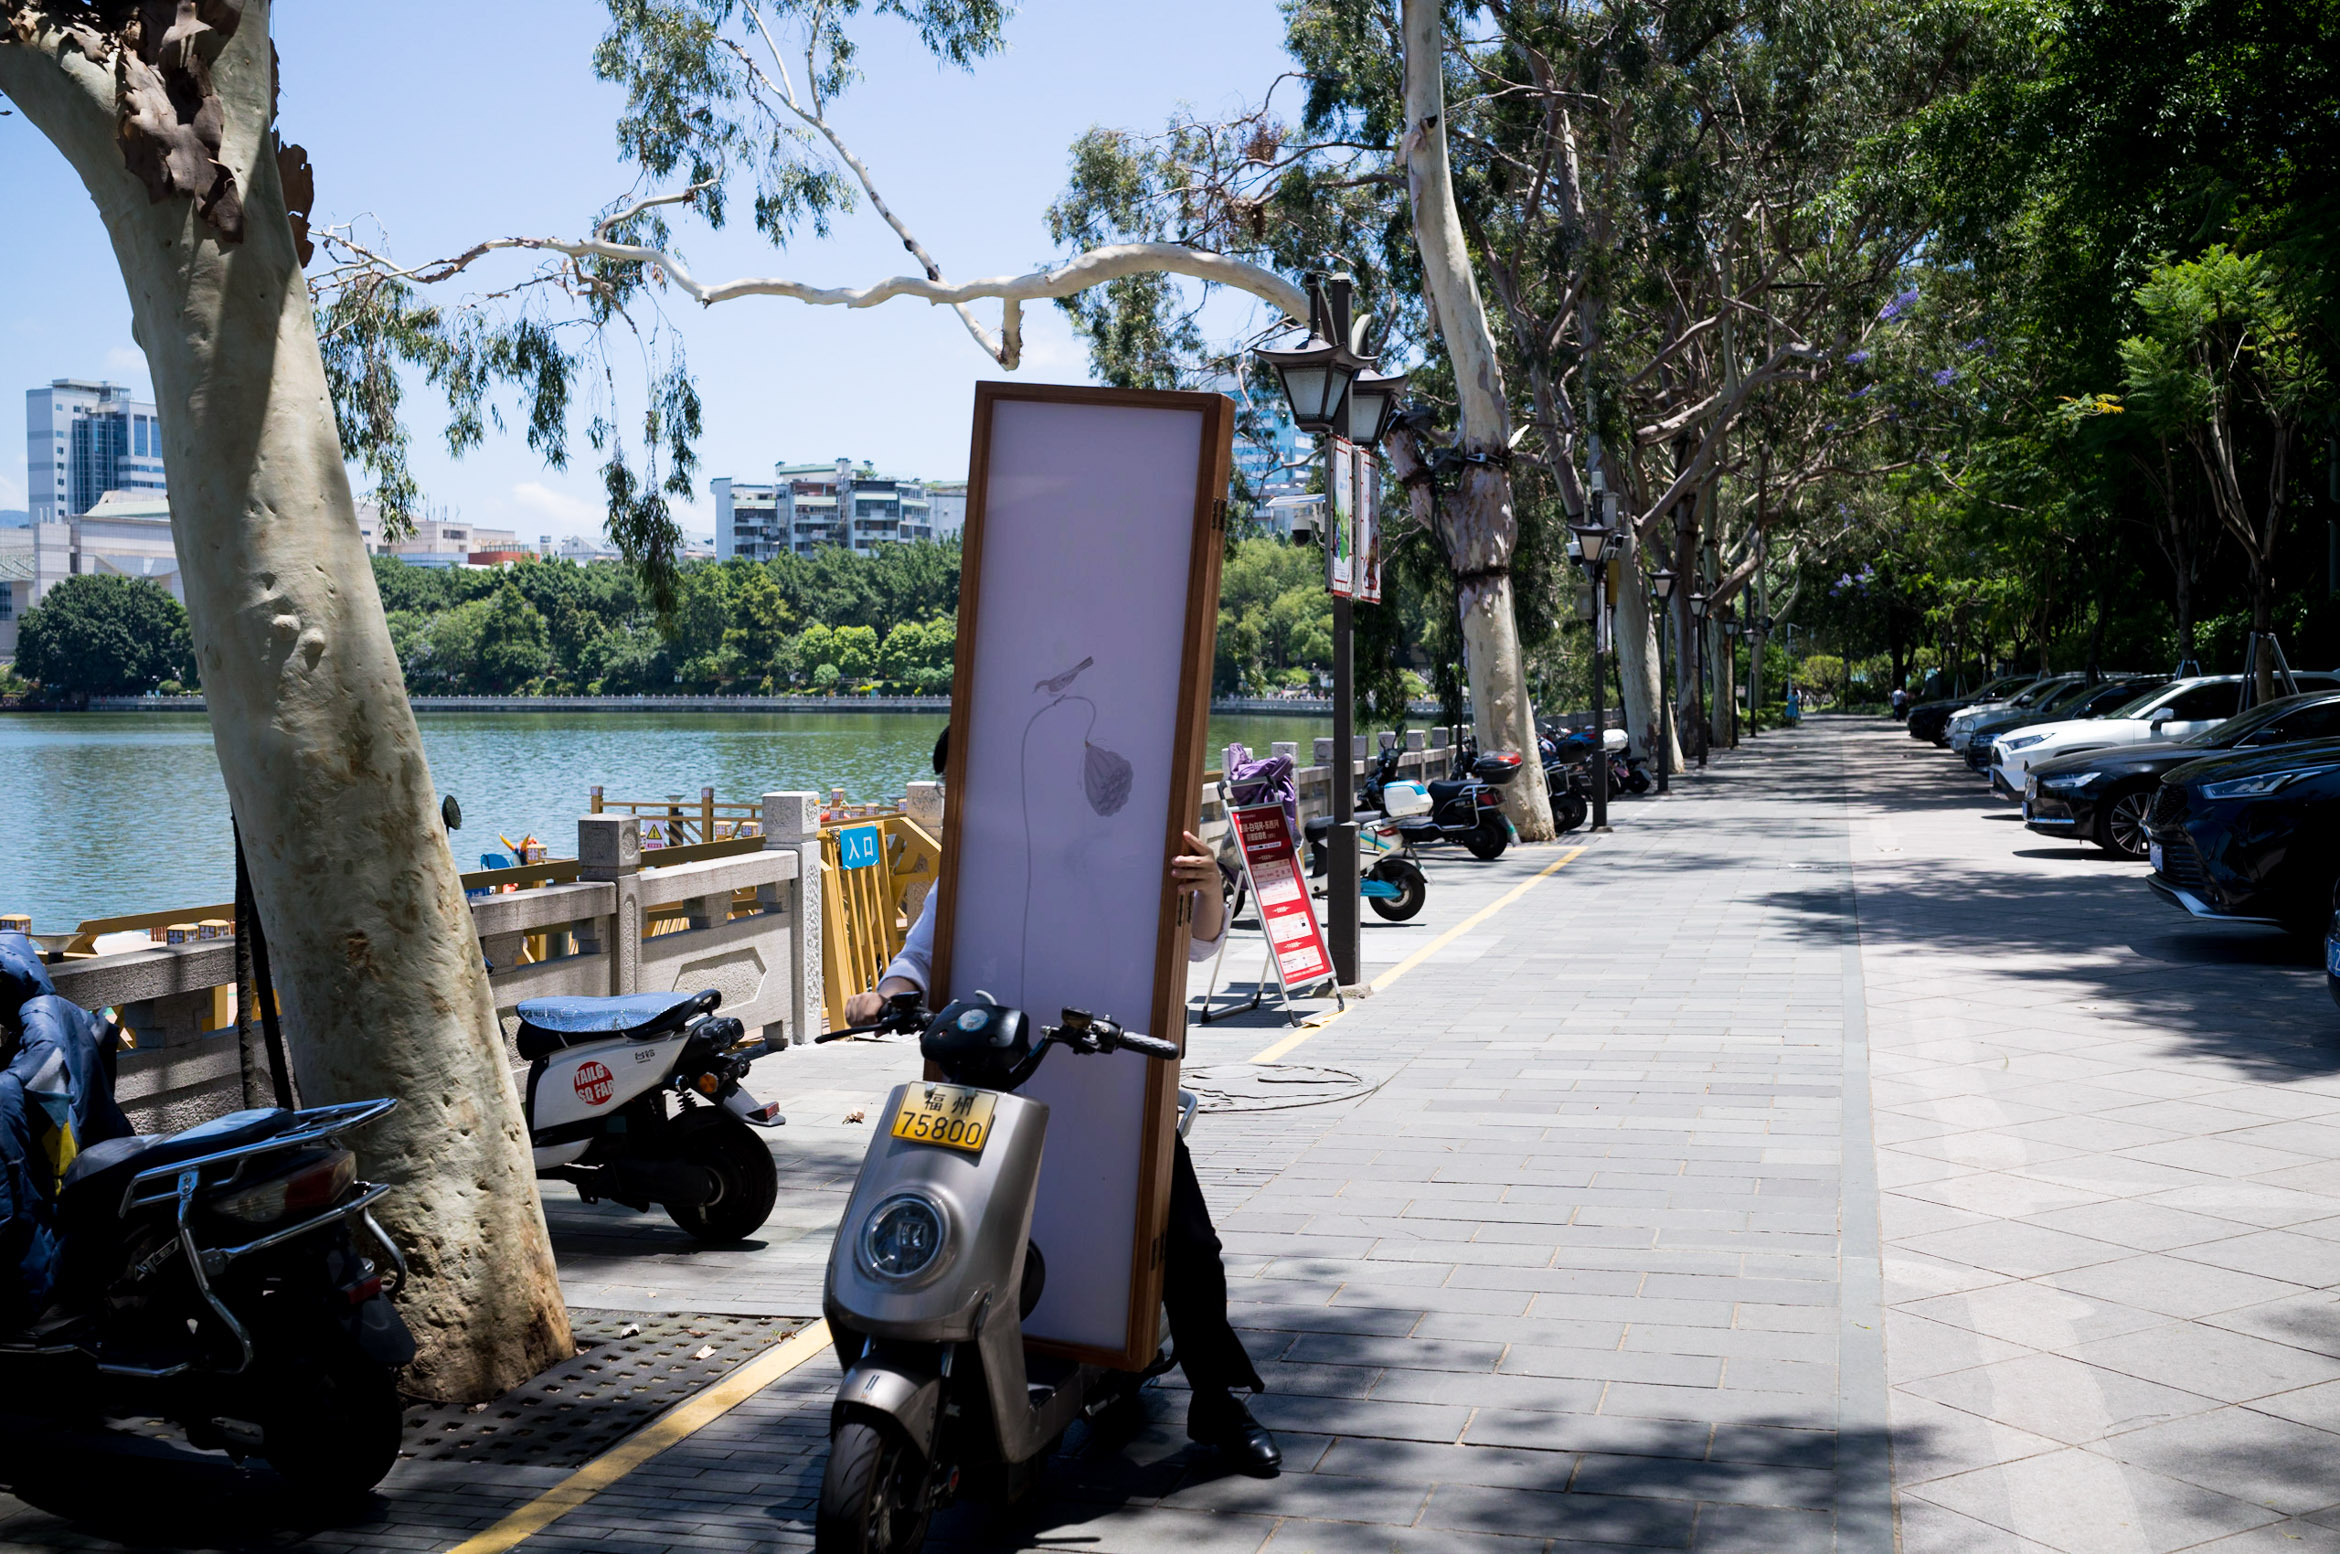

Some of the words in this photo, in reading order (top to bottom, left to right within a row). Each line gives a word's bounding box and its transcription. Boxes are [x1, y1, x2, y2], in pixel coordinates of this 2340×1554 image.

[848, 836, 874, 860] 入口
[575, 1063, 605, 1086] TAILG
[577, 1086, 594, 1102] SO
[594, 1079, 615, 1099] FAR
[924, 1093, 975, 1117] 福州
[901, 1111, 982, 1145] 75800
